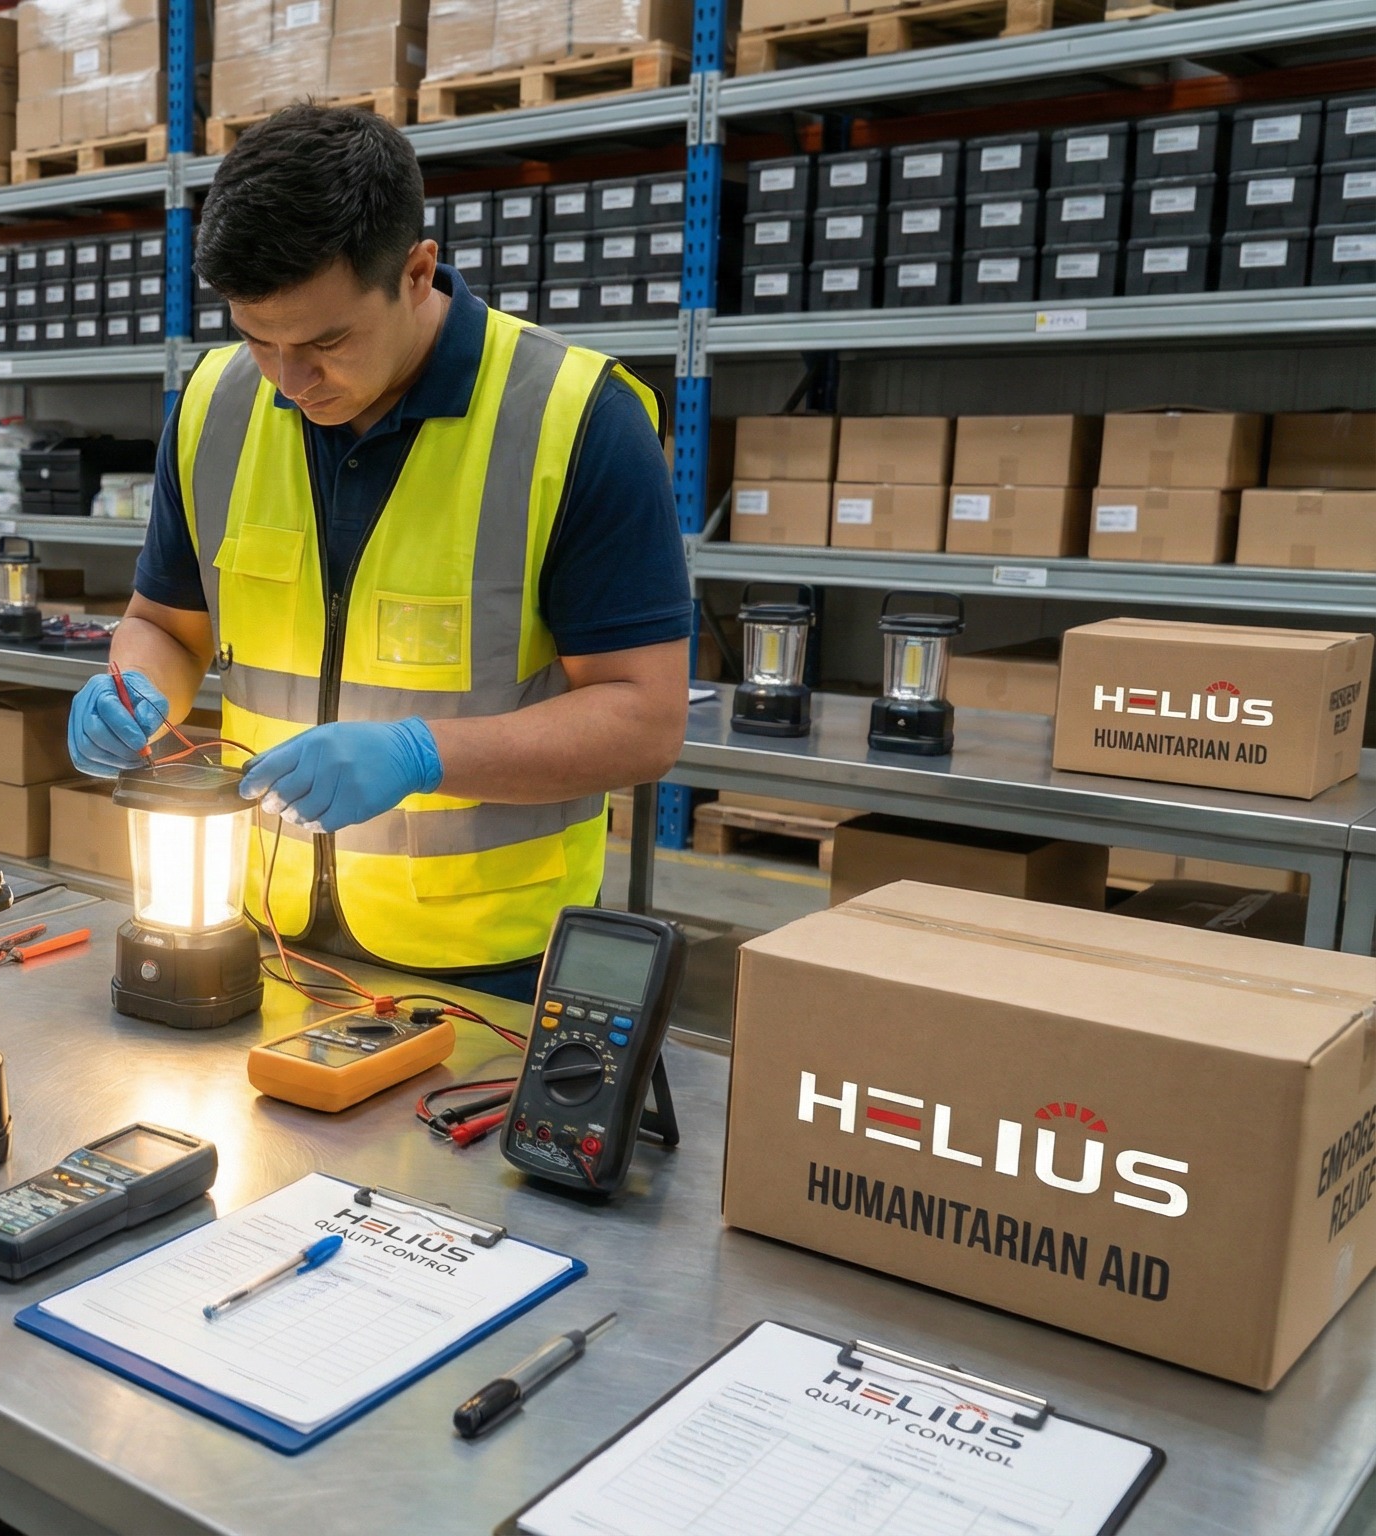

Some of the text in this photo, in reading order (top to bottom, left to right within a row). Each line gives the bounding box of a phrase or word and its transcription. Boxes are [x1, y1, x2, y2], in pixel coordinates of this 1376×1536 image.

[1093, 685, 1274, 727] HELIUS
[1094, 728, 1268, 765] HUMANITARIAN AID
[798, 1071, 1189, 1218] HELIUS
[314, 1220, 383, 1247] QUALITY
[382, 1244, 456, 1277] CONTROL
[333, 1208, 475, 1263] HELIUS
[808, 1161, 1170, 1302] HUMANITARIAN AID
[804, 1387, 901, 1426] QUALITY
[904, 1423, 1015, 1468] CONTROL
[822, 1370, 1025, 1450] HELIUS
